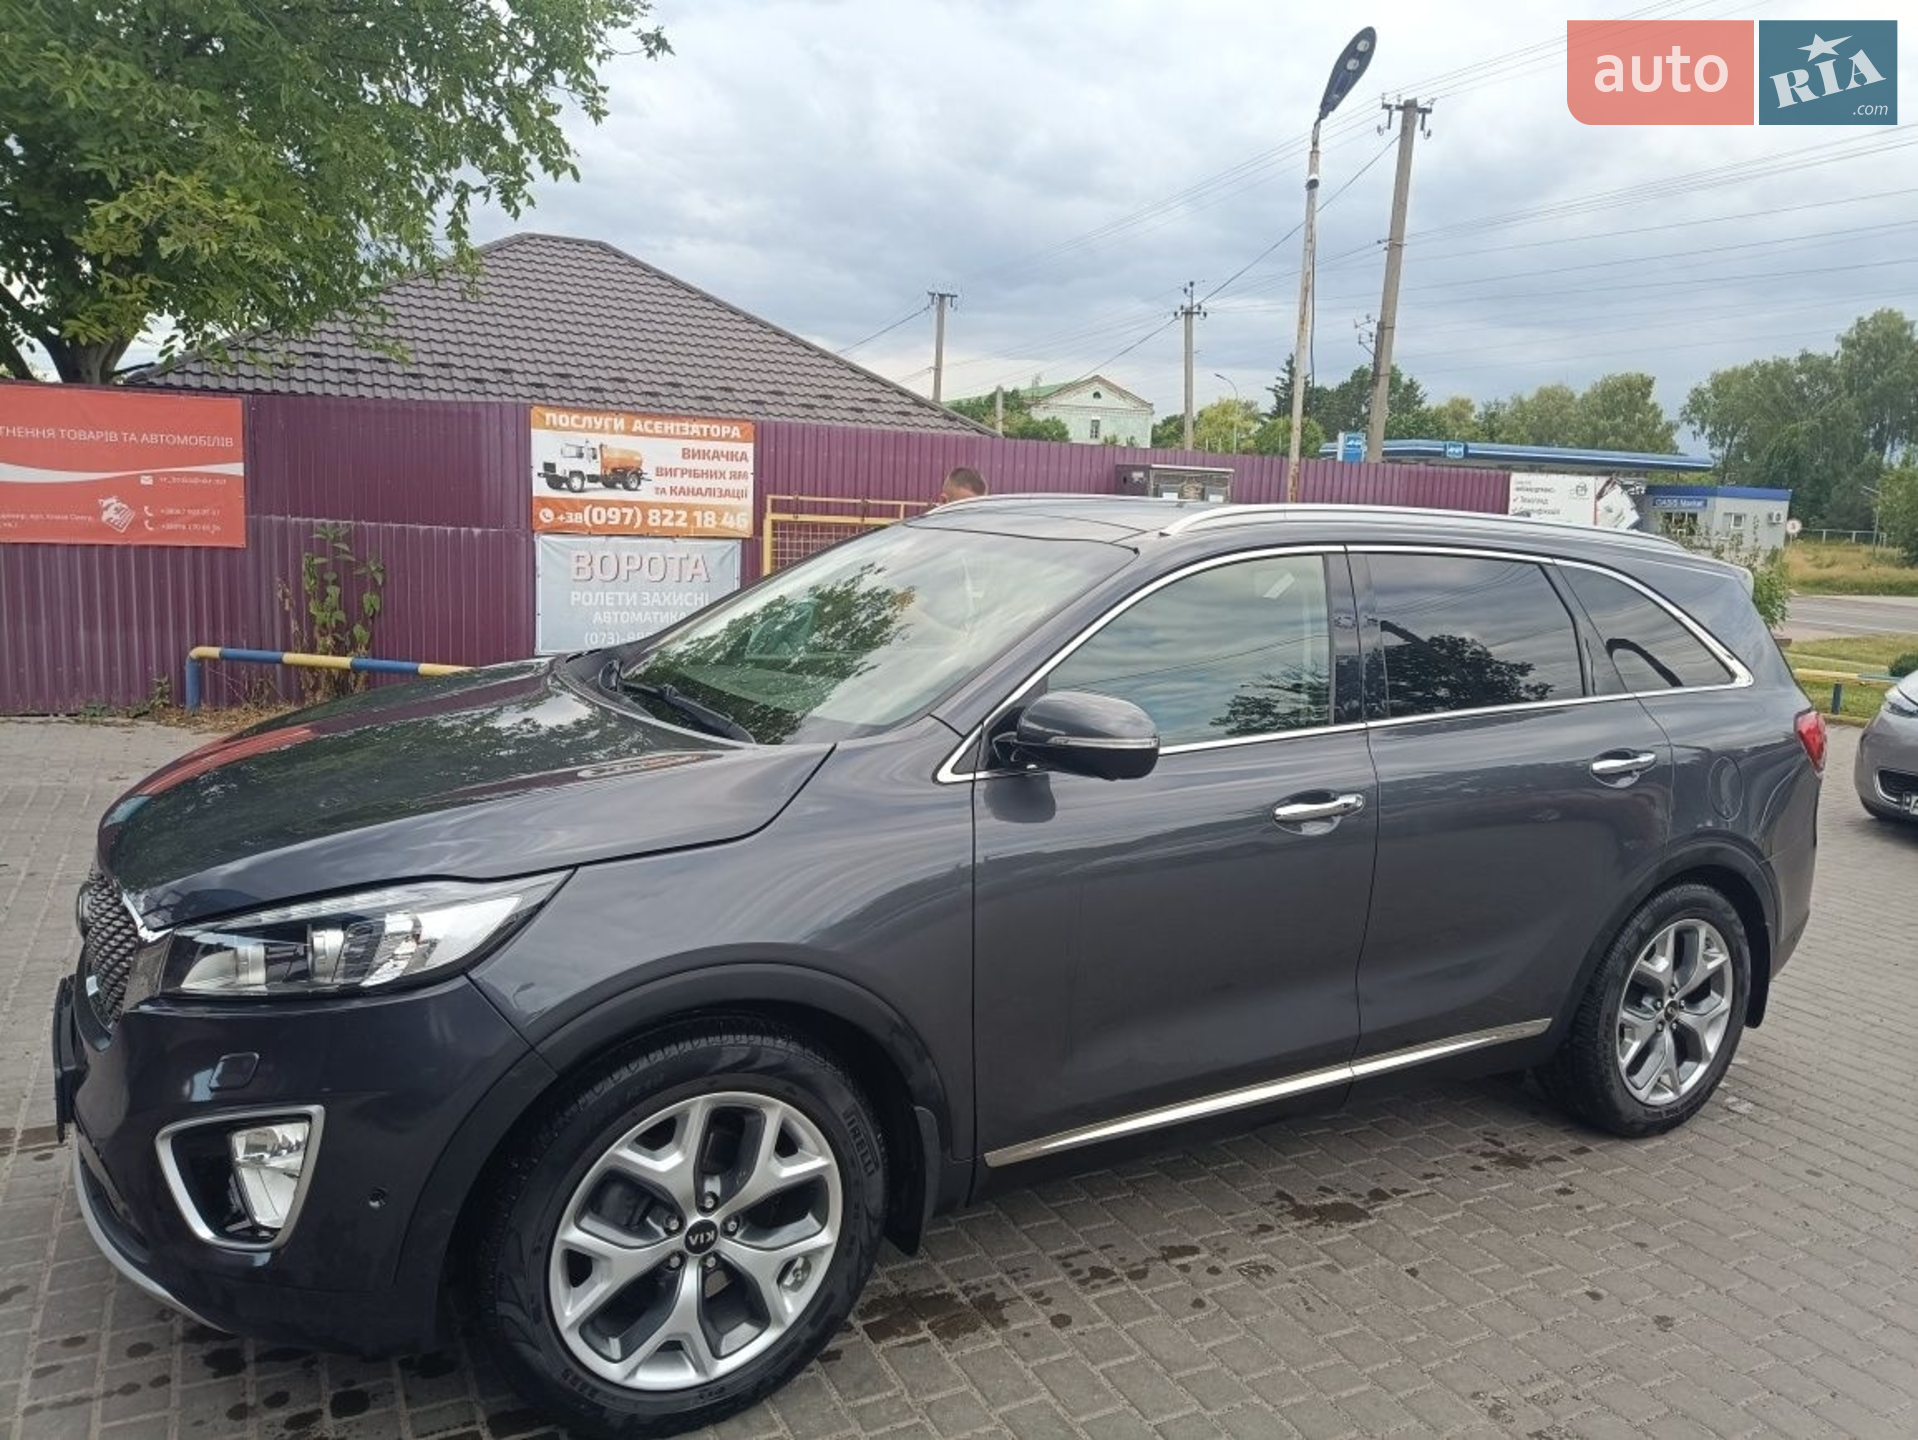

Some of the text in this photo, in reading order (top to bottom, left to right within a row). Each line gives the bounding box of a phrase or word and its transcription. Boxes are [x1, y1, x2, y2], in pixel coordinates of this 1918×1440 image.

[545, 412, 742, 439] ПОСЛУГИ АСЕНІЗАТОРА
[59, 429, 119, 443] ТОВАРІВ
[122, 432, 137, 443] ТА
[140, 432, 234, 448] АВТОМОБІЛІВ
[681, 447, 749, 463] ВИКАЧКА
[655, 466, 727, 480] ВИГРІБНИХ
[669, 485, 748, 500] КАНАЛІЗАЦІЇ
[648, 508, 687, 527] 822
[693, 510, 716, 529] 18
[570, 549, 711, 583] ВОРОТА
[571, 591, 709, 606] РОЛЕТИ ЗАХИСНІ
[689, 1230, 715, 1246] KIA
